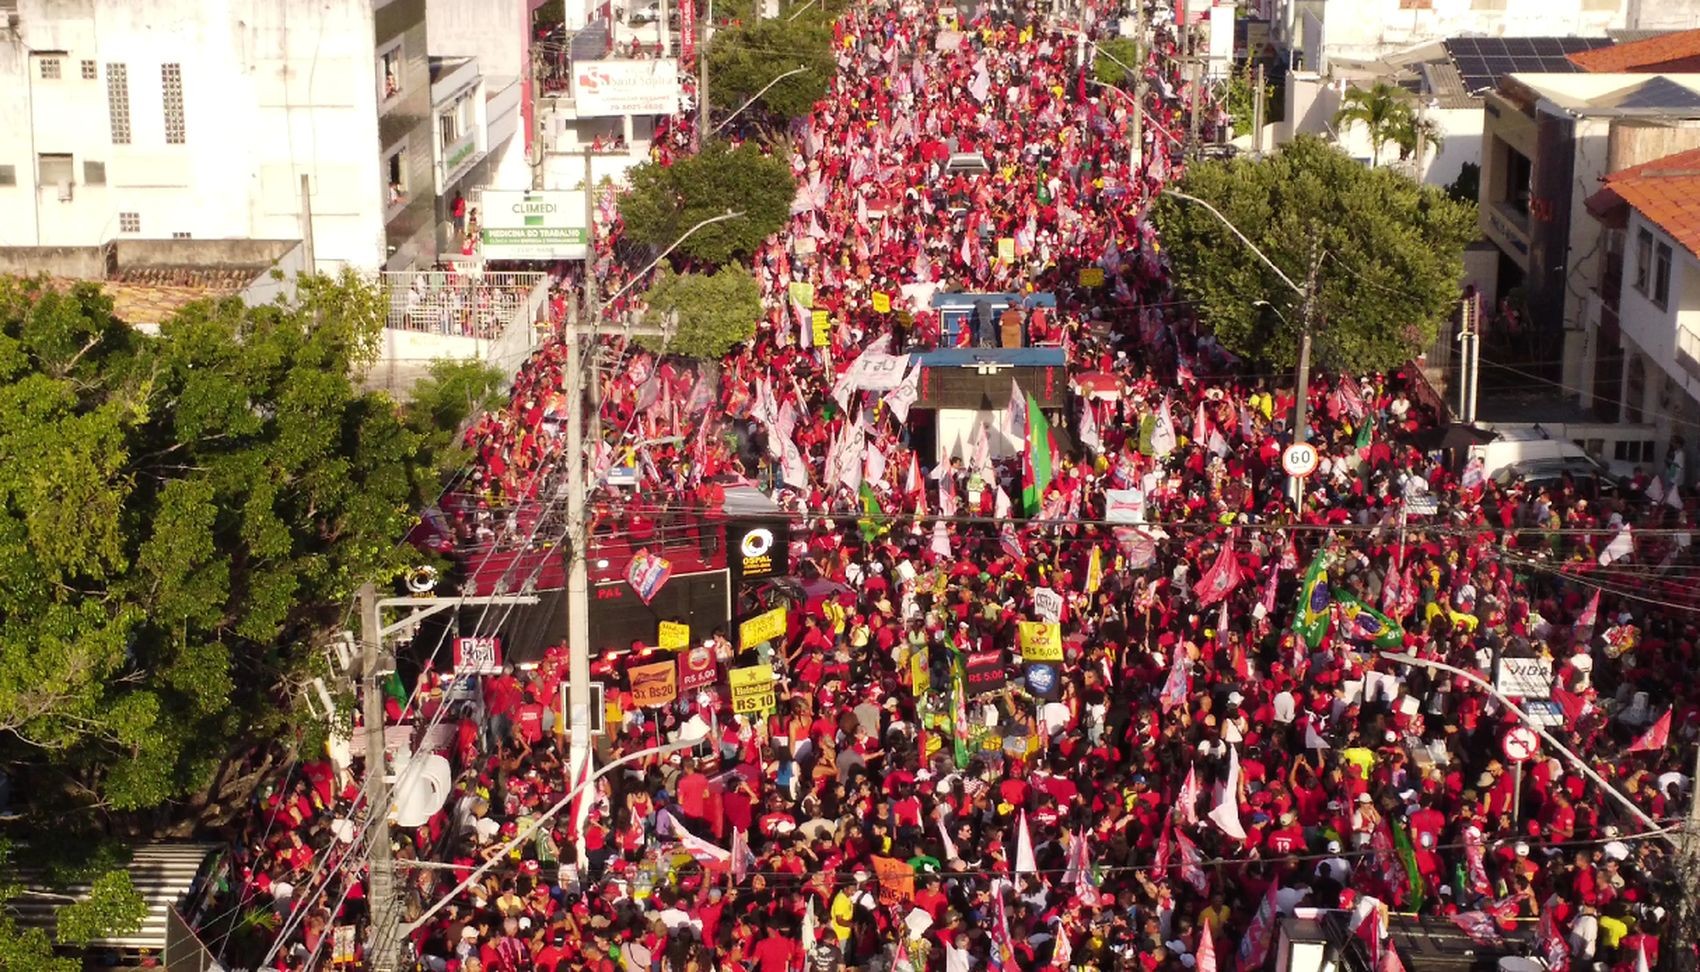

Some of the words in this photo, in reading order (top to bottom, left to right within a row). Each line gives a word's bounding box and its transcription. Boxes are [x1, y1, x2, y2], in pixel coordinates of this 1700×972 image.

[512, 203, 557, 214] CLIMEDI
[489, 229, 525, 237] MEDICINA
[540, 229, 580, 237] TRABALHO
[1291, 450, 1310, 464] 60
[742, 555, 772, 566] OSPAL
[968, 673, 982, 683] R$
[760, 695, 773, 706] 10
